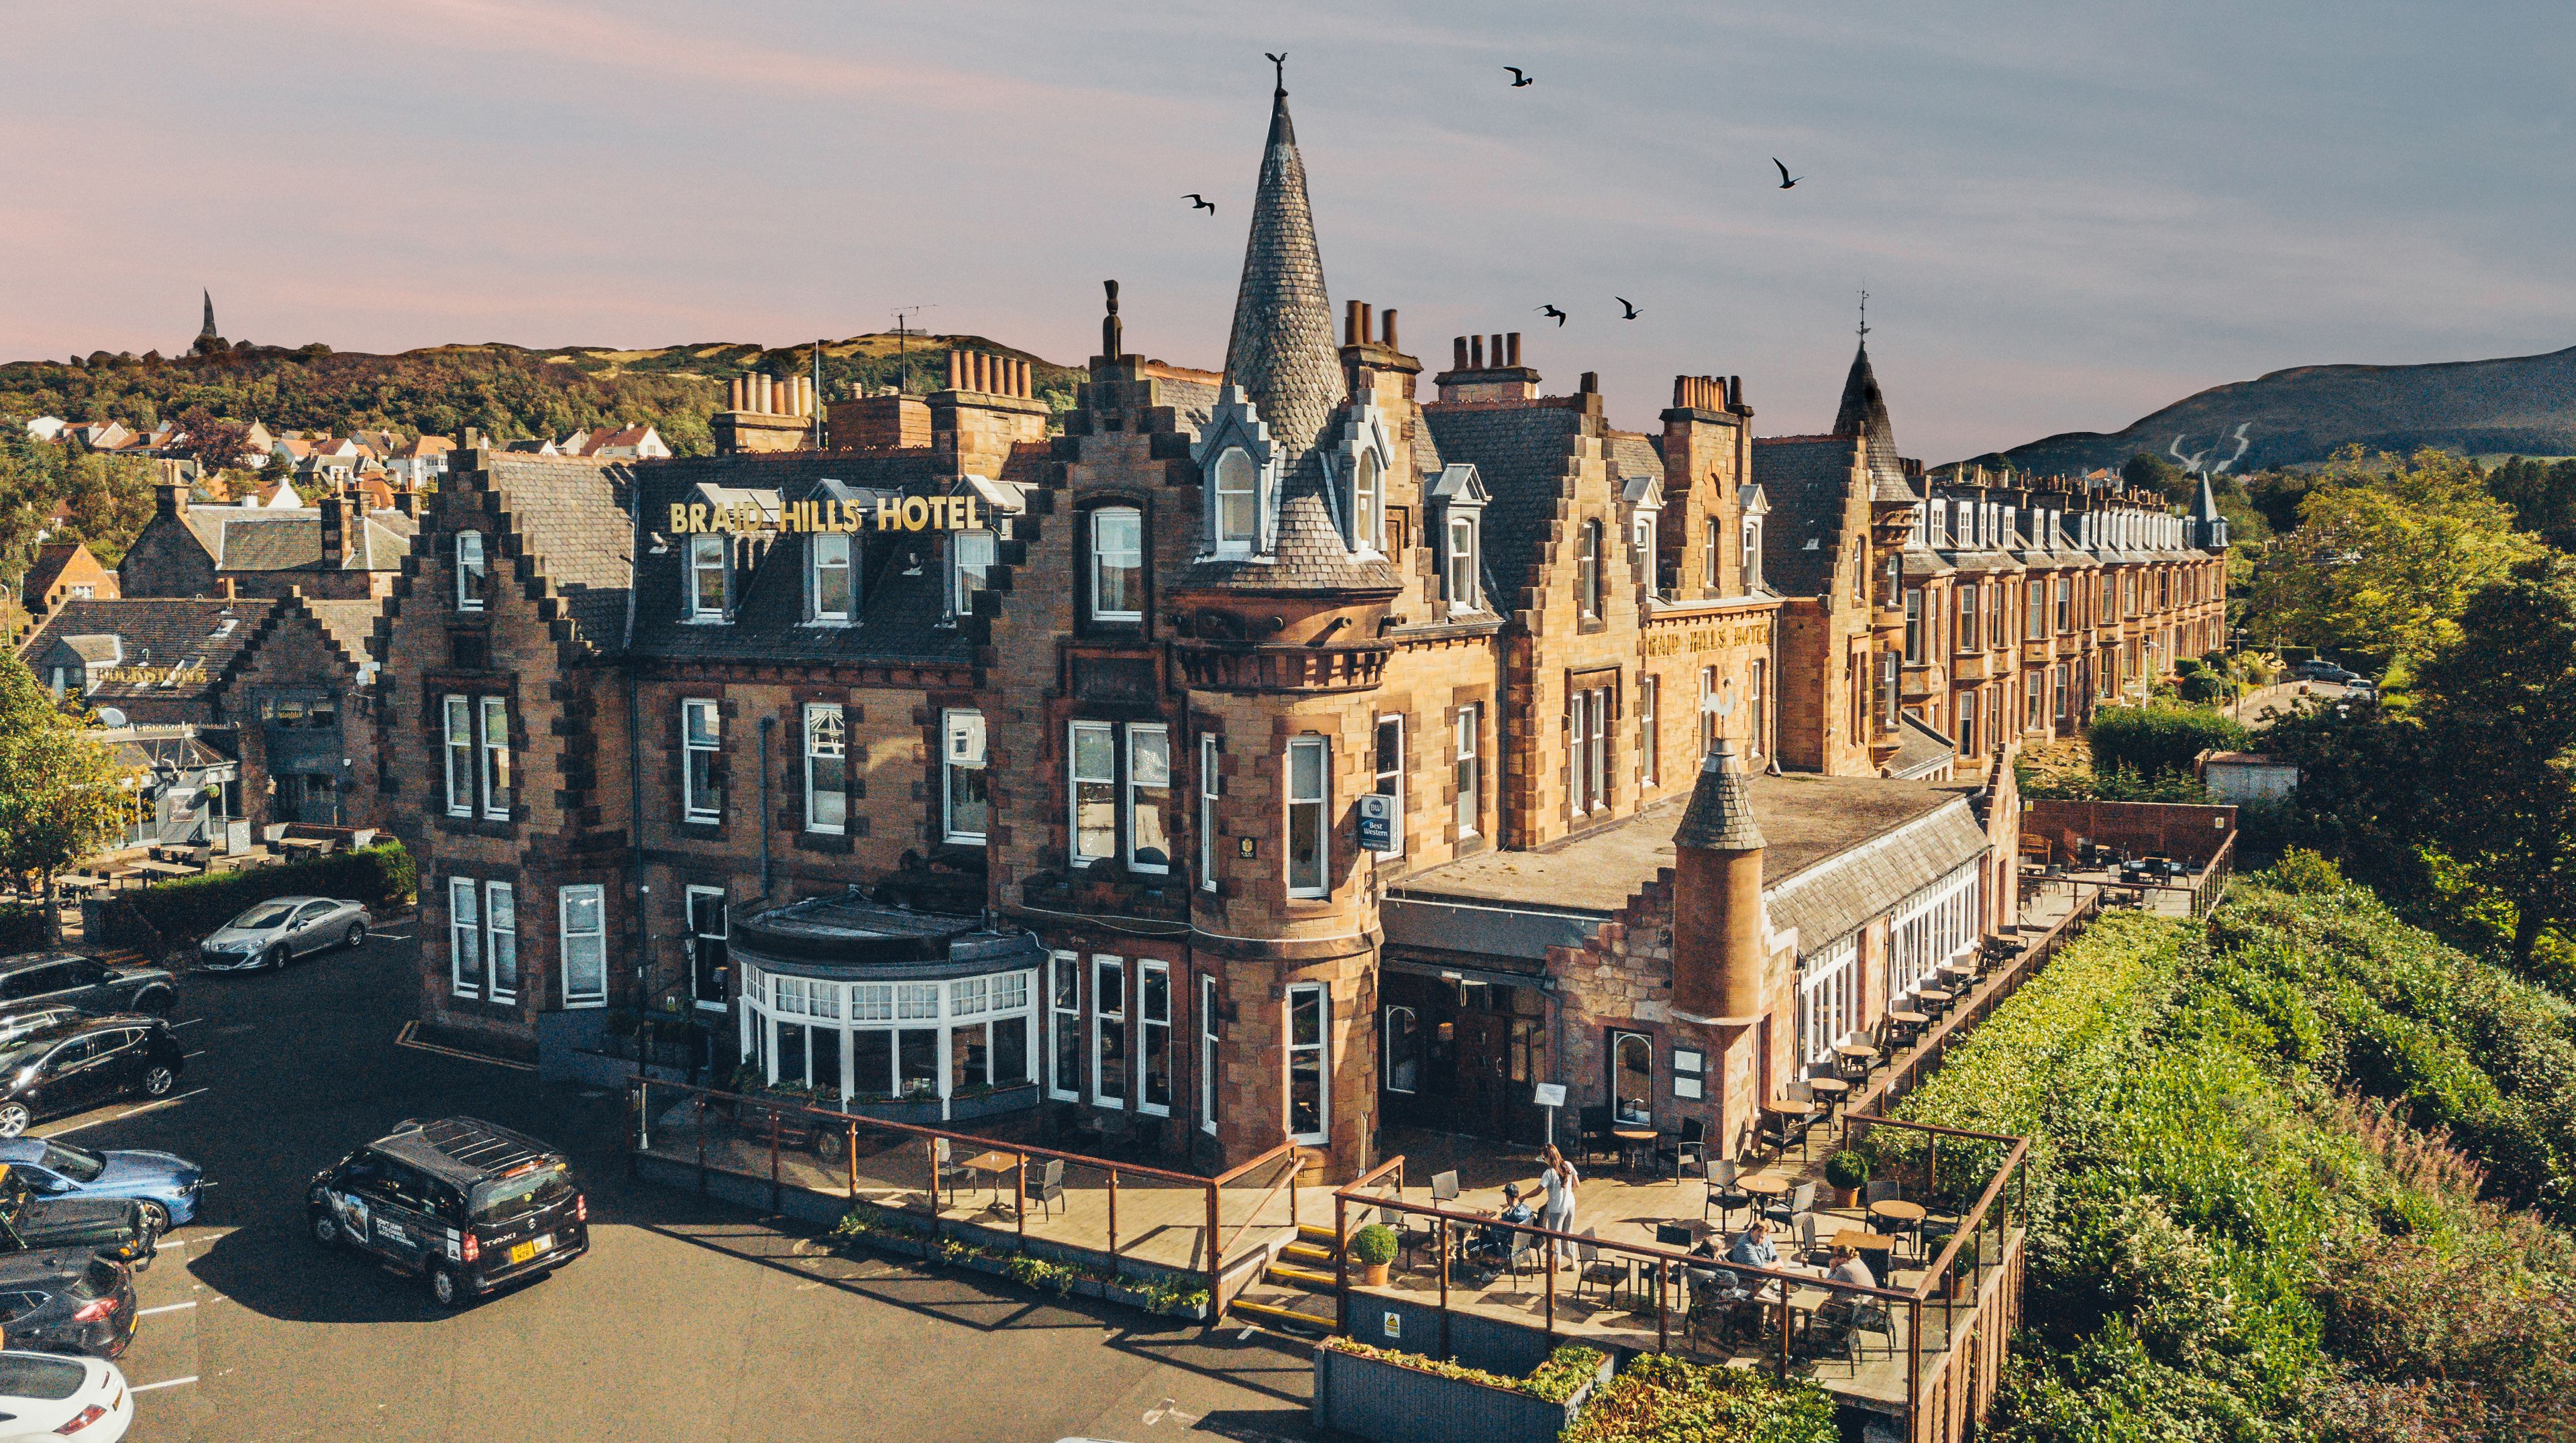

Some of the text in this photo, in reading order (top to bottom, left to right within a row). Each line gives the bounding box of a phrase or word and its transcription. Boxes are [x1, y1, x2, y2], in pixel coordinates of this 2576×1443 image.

[670, 495, 983, 533] BRAID HILLS HOTEL
[1646, 632, 1680, 657] RAID
[1689, 627, 1727, 653] HILLS
[1371, 804, 1382, 812] BW
[1369, 822, 1383, 830] Best
[1364, 828, 1388, 837] Western
[482, 1232, 517, 1247] TAXI
